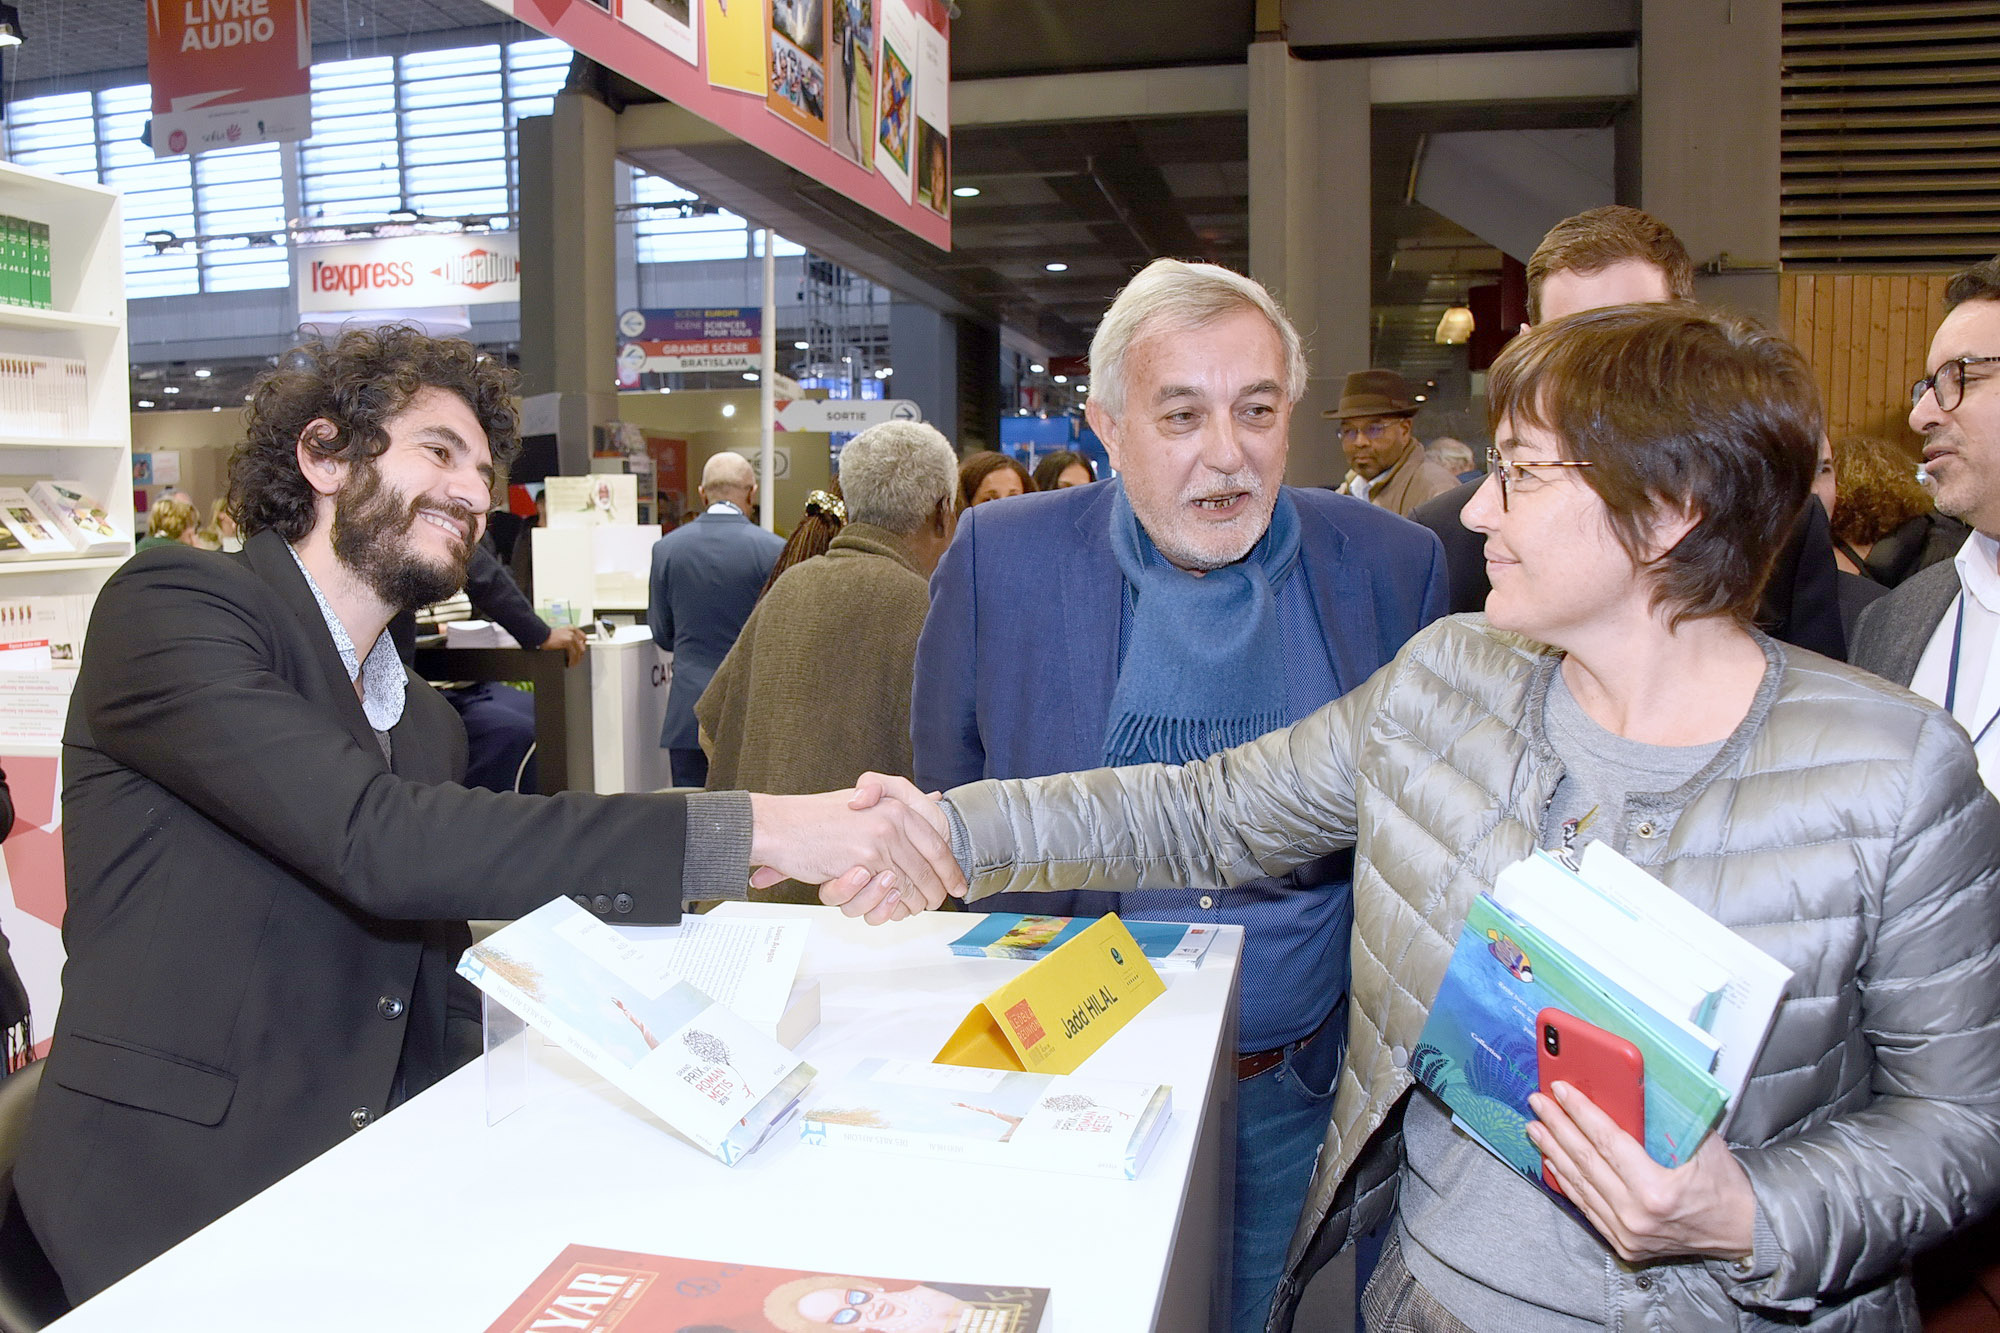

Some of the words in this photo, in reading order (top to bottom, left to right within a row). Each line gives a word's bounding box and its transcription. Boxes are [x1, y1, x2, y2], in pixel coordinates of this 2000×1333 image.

[185, 0, 269, 24] LIVRE
[181, 17, 275, 52] AUDIO
[312, 261, 414, 296] l'express
[704, 321, 746, 329] SCIENCES
[704, 329, 728, 337] POUR
[730, 328, 753, 337] TOUS
[662, 343, 710, 354] GRANDE
[681, 357, 748, 368] BRATISLAVA
[826, 412, 867, 421] SORTIE
[766, 941, 780, 963] Aragon
[1061, 1004, 1090, 1039] Jadd
[1083, 985, 1118, 1020] HILAL
[1471, 1032, 1502, 1061] Collection
[683, 1066, 706, 1085] PRIX
[695, 1067, 726, 1094] ROMAN
[1076, 1111, 1098, 1131] ROMAN
[524, 1272, 631, 1333] YAR
